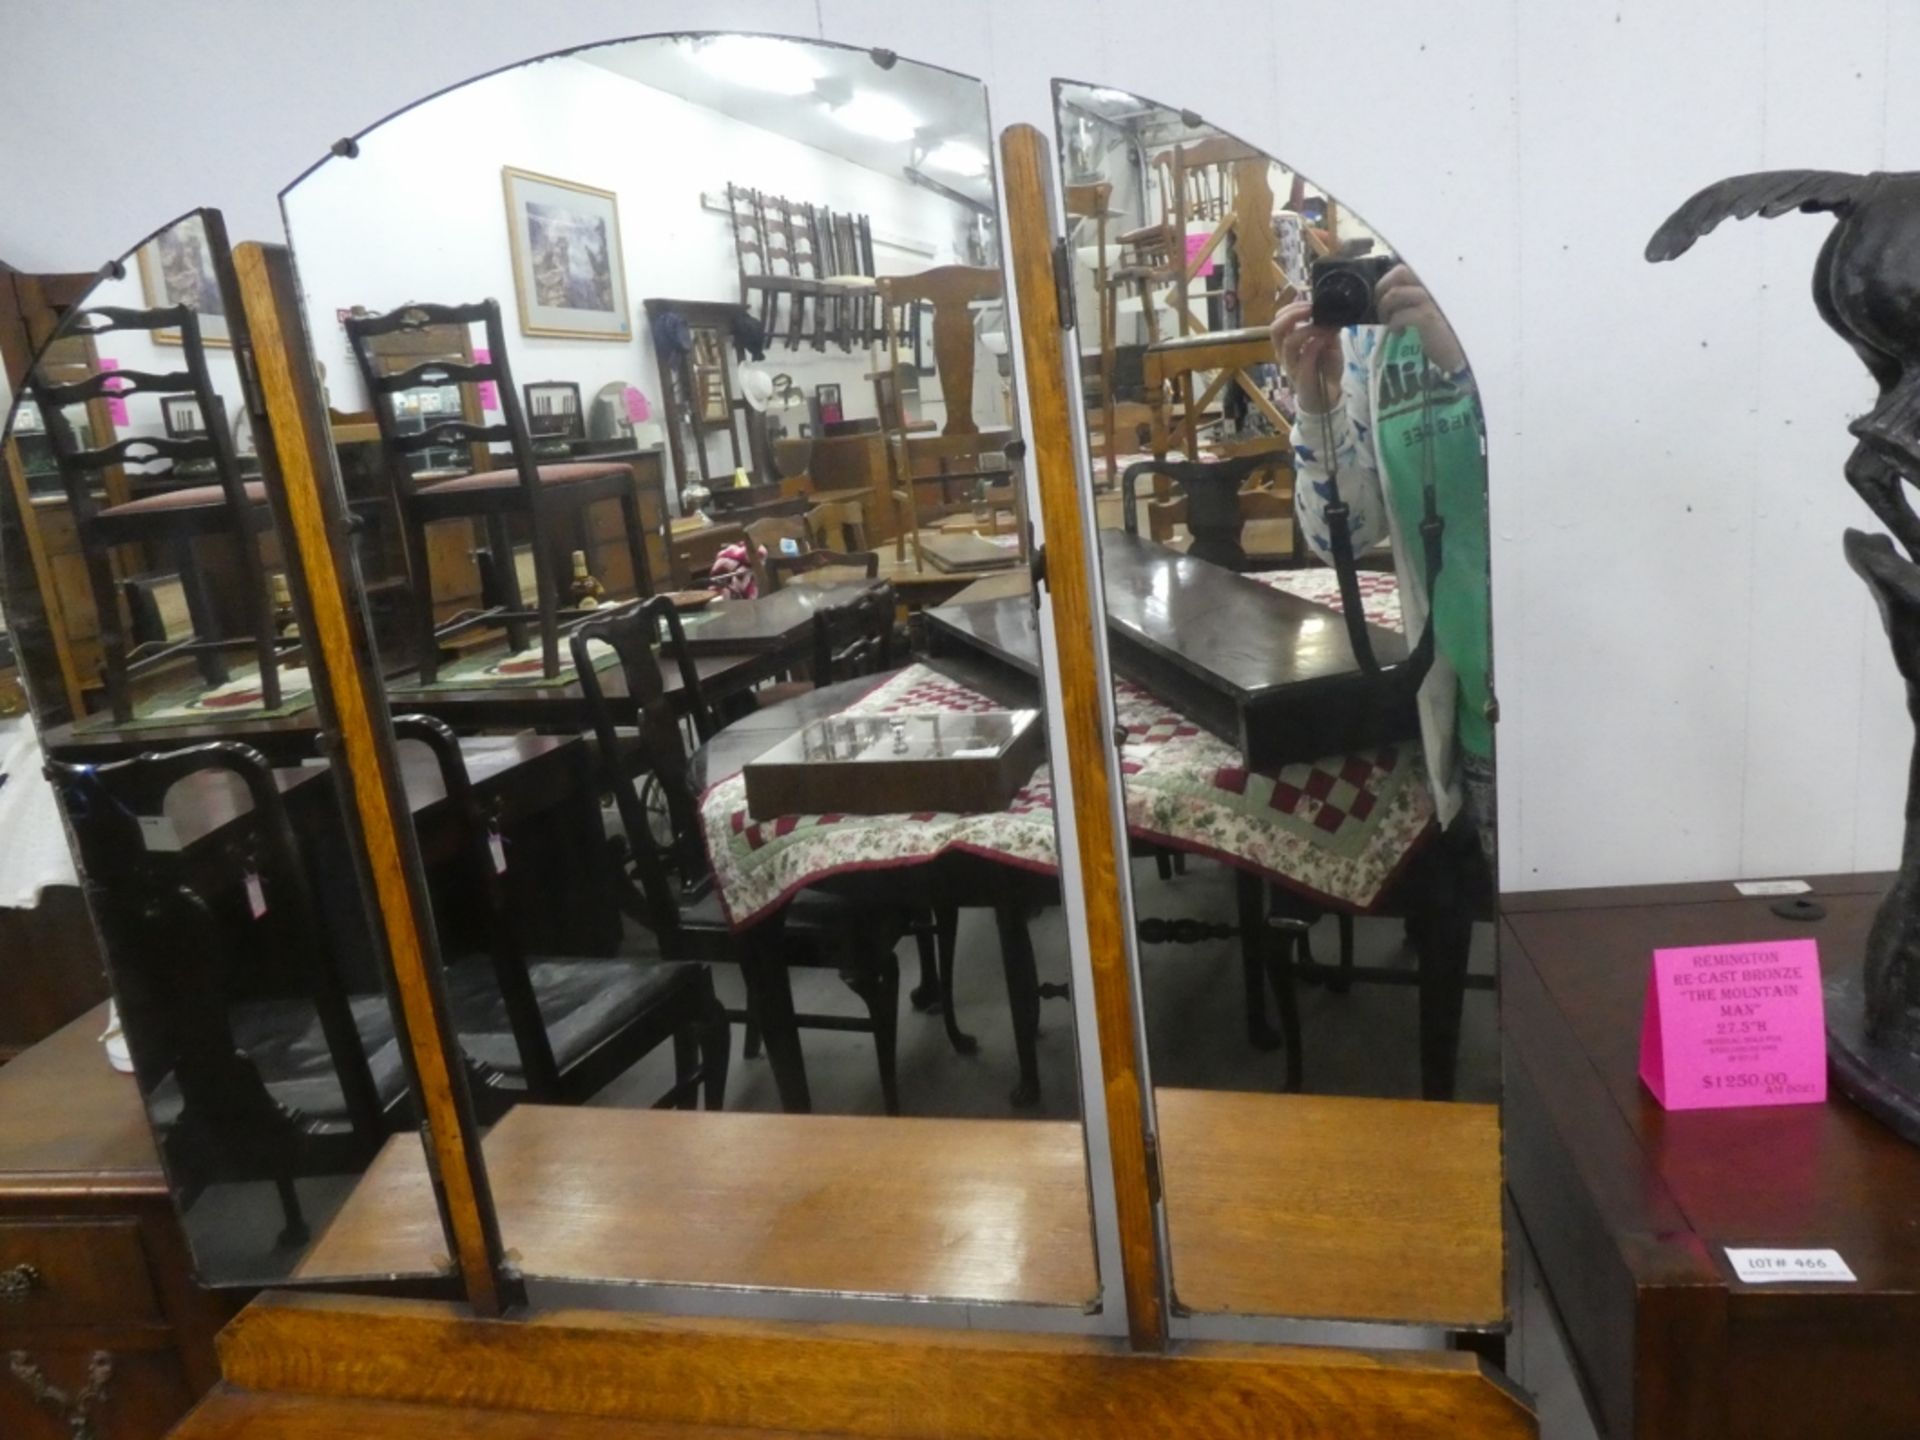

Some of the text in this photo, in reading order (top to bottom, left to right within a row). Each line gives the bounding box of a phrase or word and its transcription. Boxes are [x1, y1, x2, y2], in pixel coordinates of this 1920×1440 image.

[1692, 950, 1780, 968] REMINGTON
[1673, 967, 1803, 986] RE-CAST BRONZE
[1720, 984, 1799, 1000] MOUNTAIN
[1702, 1072, 1788, 1089] $1250.00
[1795, 1258, 1827, 1268] 466
